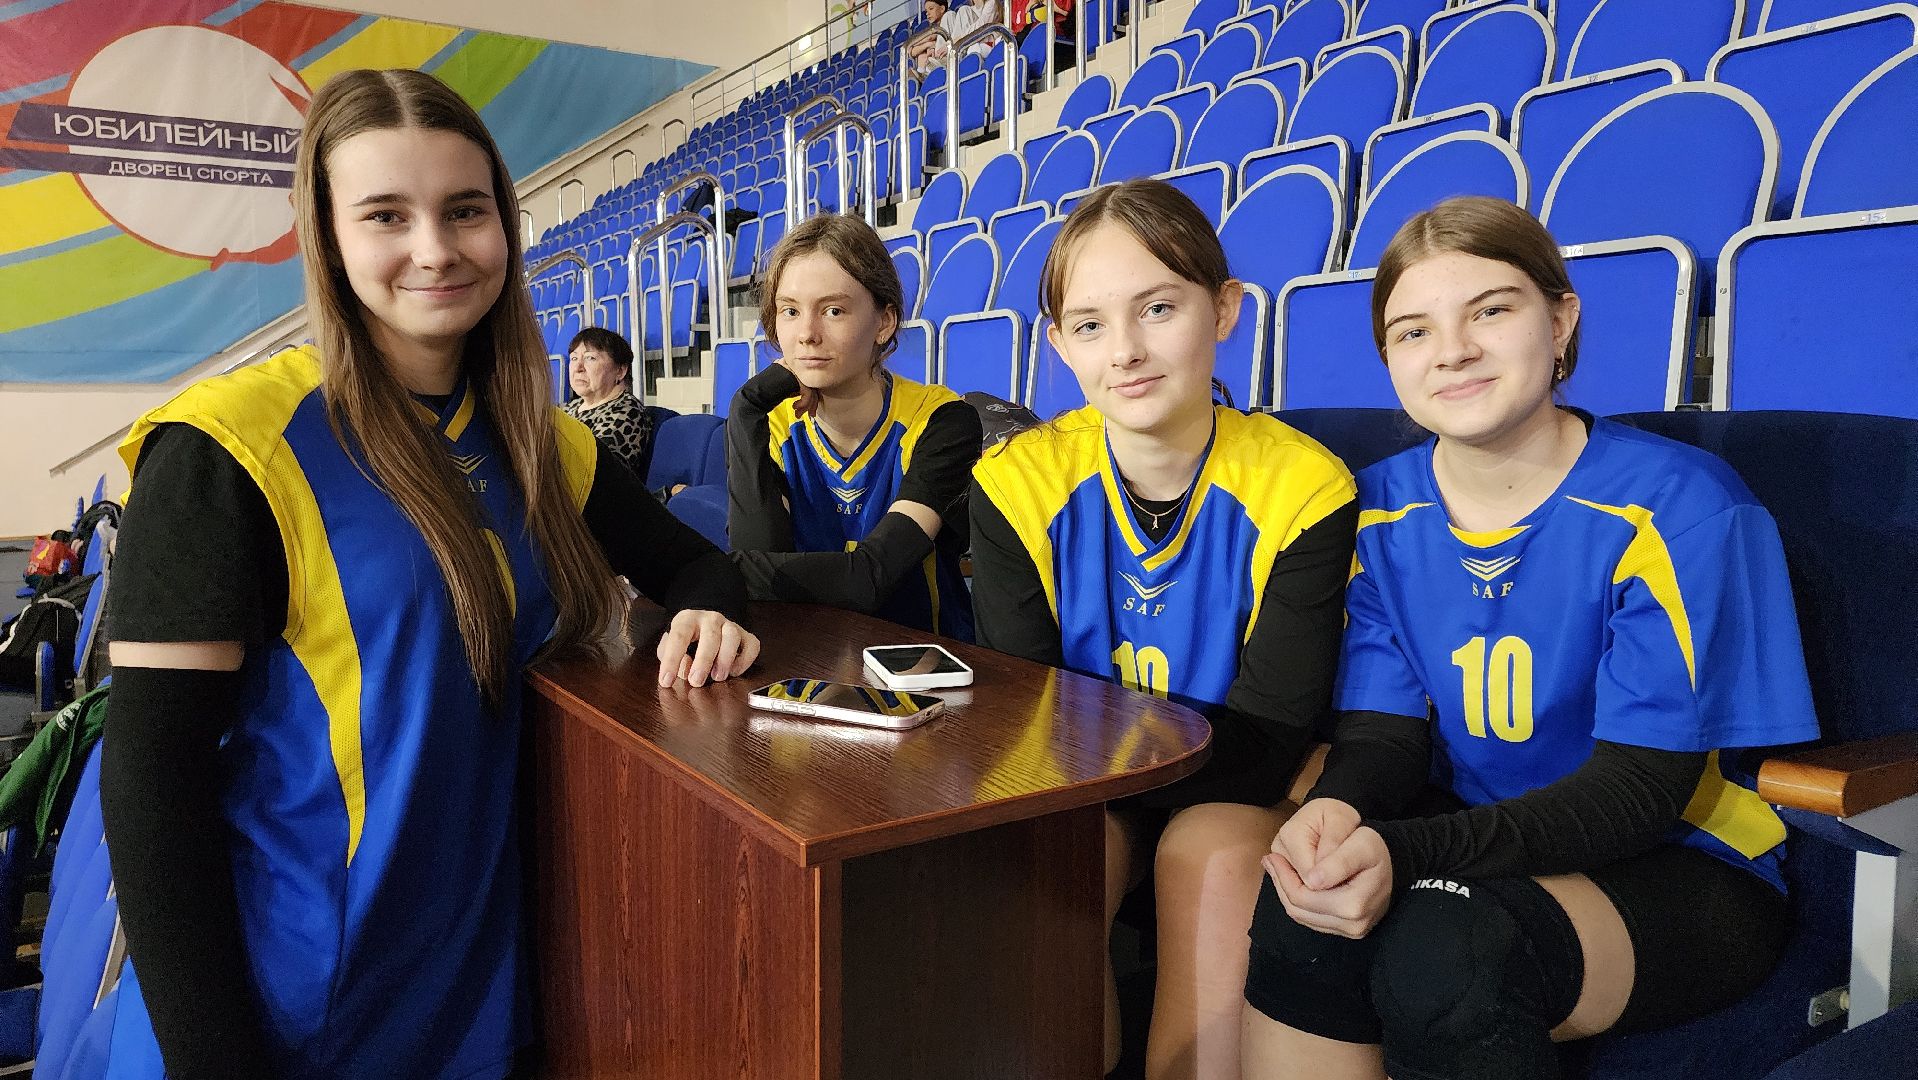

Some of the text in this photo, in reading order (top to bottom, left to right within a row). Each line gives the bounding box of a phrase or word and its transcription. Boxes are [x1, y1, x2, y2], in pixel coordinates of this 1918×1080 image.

[54, 112, 302, 154] ЮБИЛЕЙНЫЙ
[108, 160, 274, 185] ДВОРЕЦ СПОРТА
[466, 479, 488, 493] AF
[836, 503, 863, 515] SAF
[1472, 581, 1514, 599] SAF
[1123, 597, 1165, 617] SAF
[1111, 640, 1169, 701] 10
[1451, 635, 1534, 743] 10
[1410, 878, 1471, 899] IKASA
